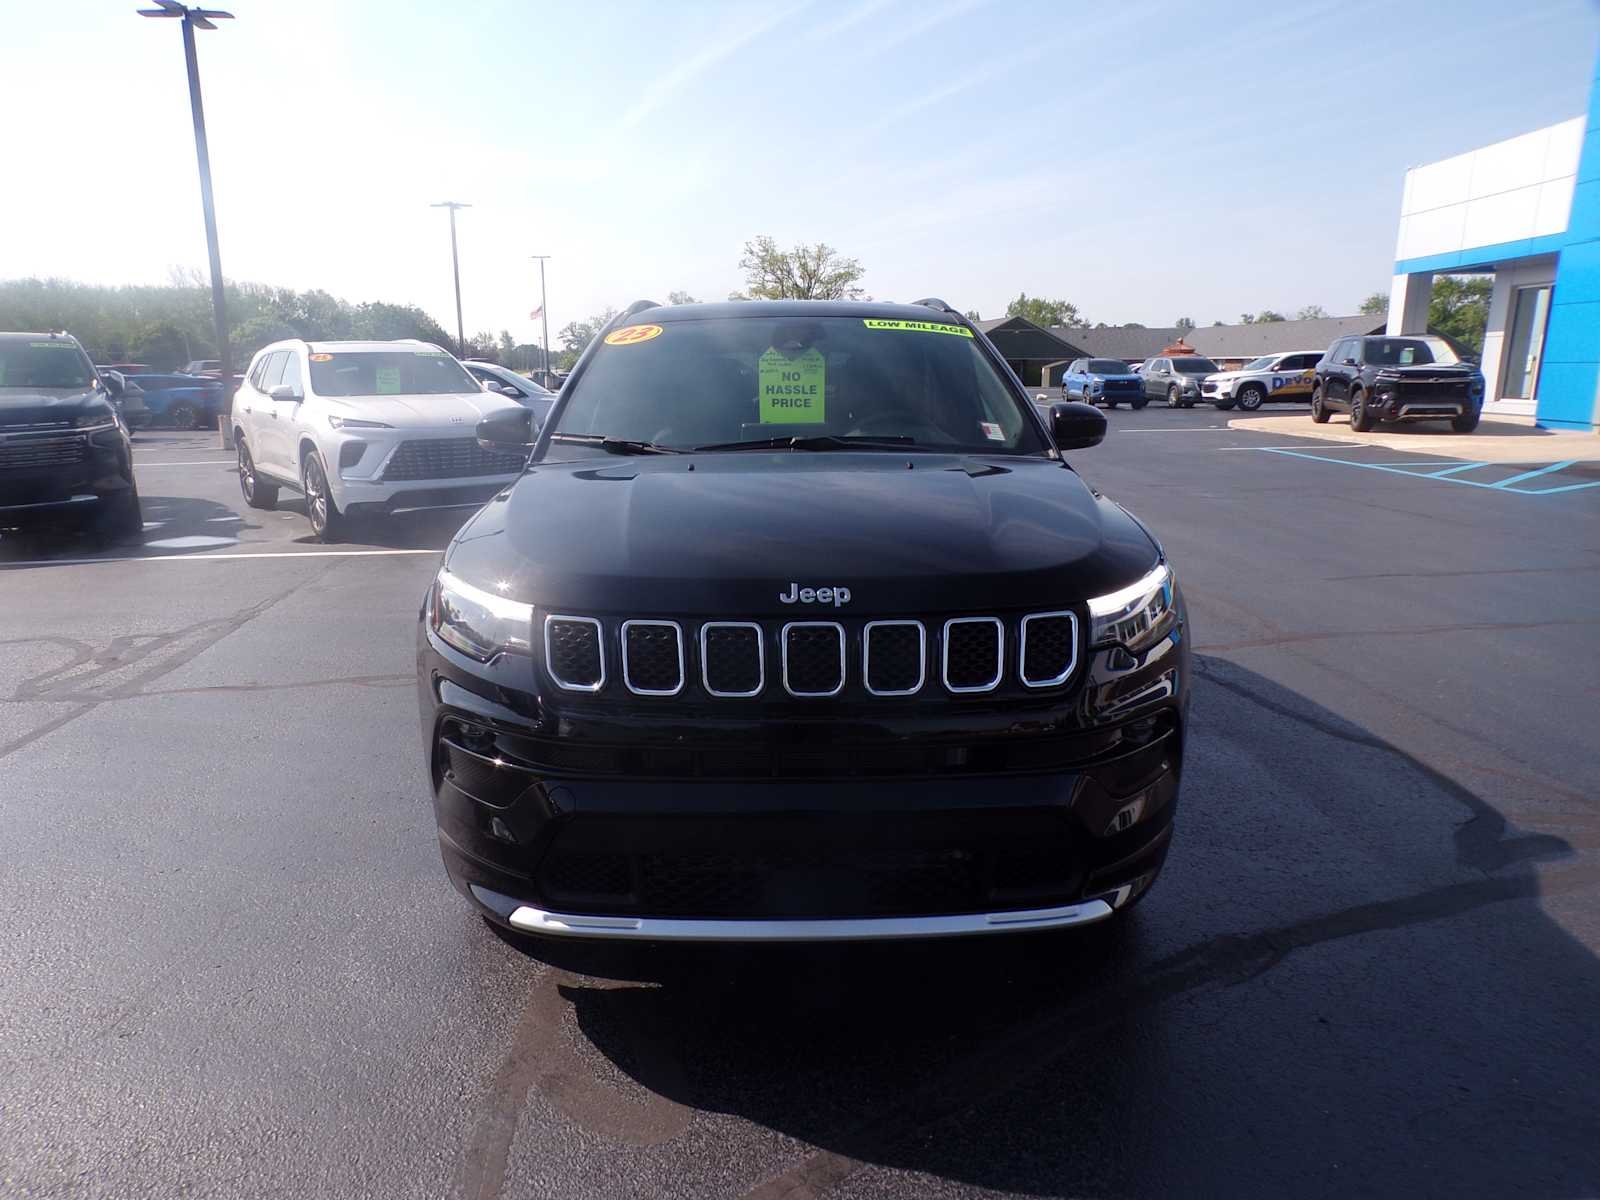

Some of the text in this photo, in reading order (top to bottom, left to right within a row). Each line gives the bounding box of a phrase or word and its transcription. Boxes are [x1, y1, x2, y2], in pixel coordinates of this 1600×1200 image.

[905, 322, 969, 335] MILEAGE
[611, 327, 655, 343] 23
[782, 371, 801, 382] NO
[766, 384, 817, 395] HASSLE
[771, 398, 812, 408] PRICE
[779, 582, 851, 608] Jeep
